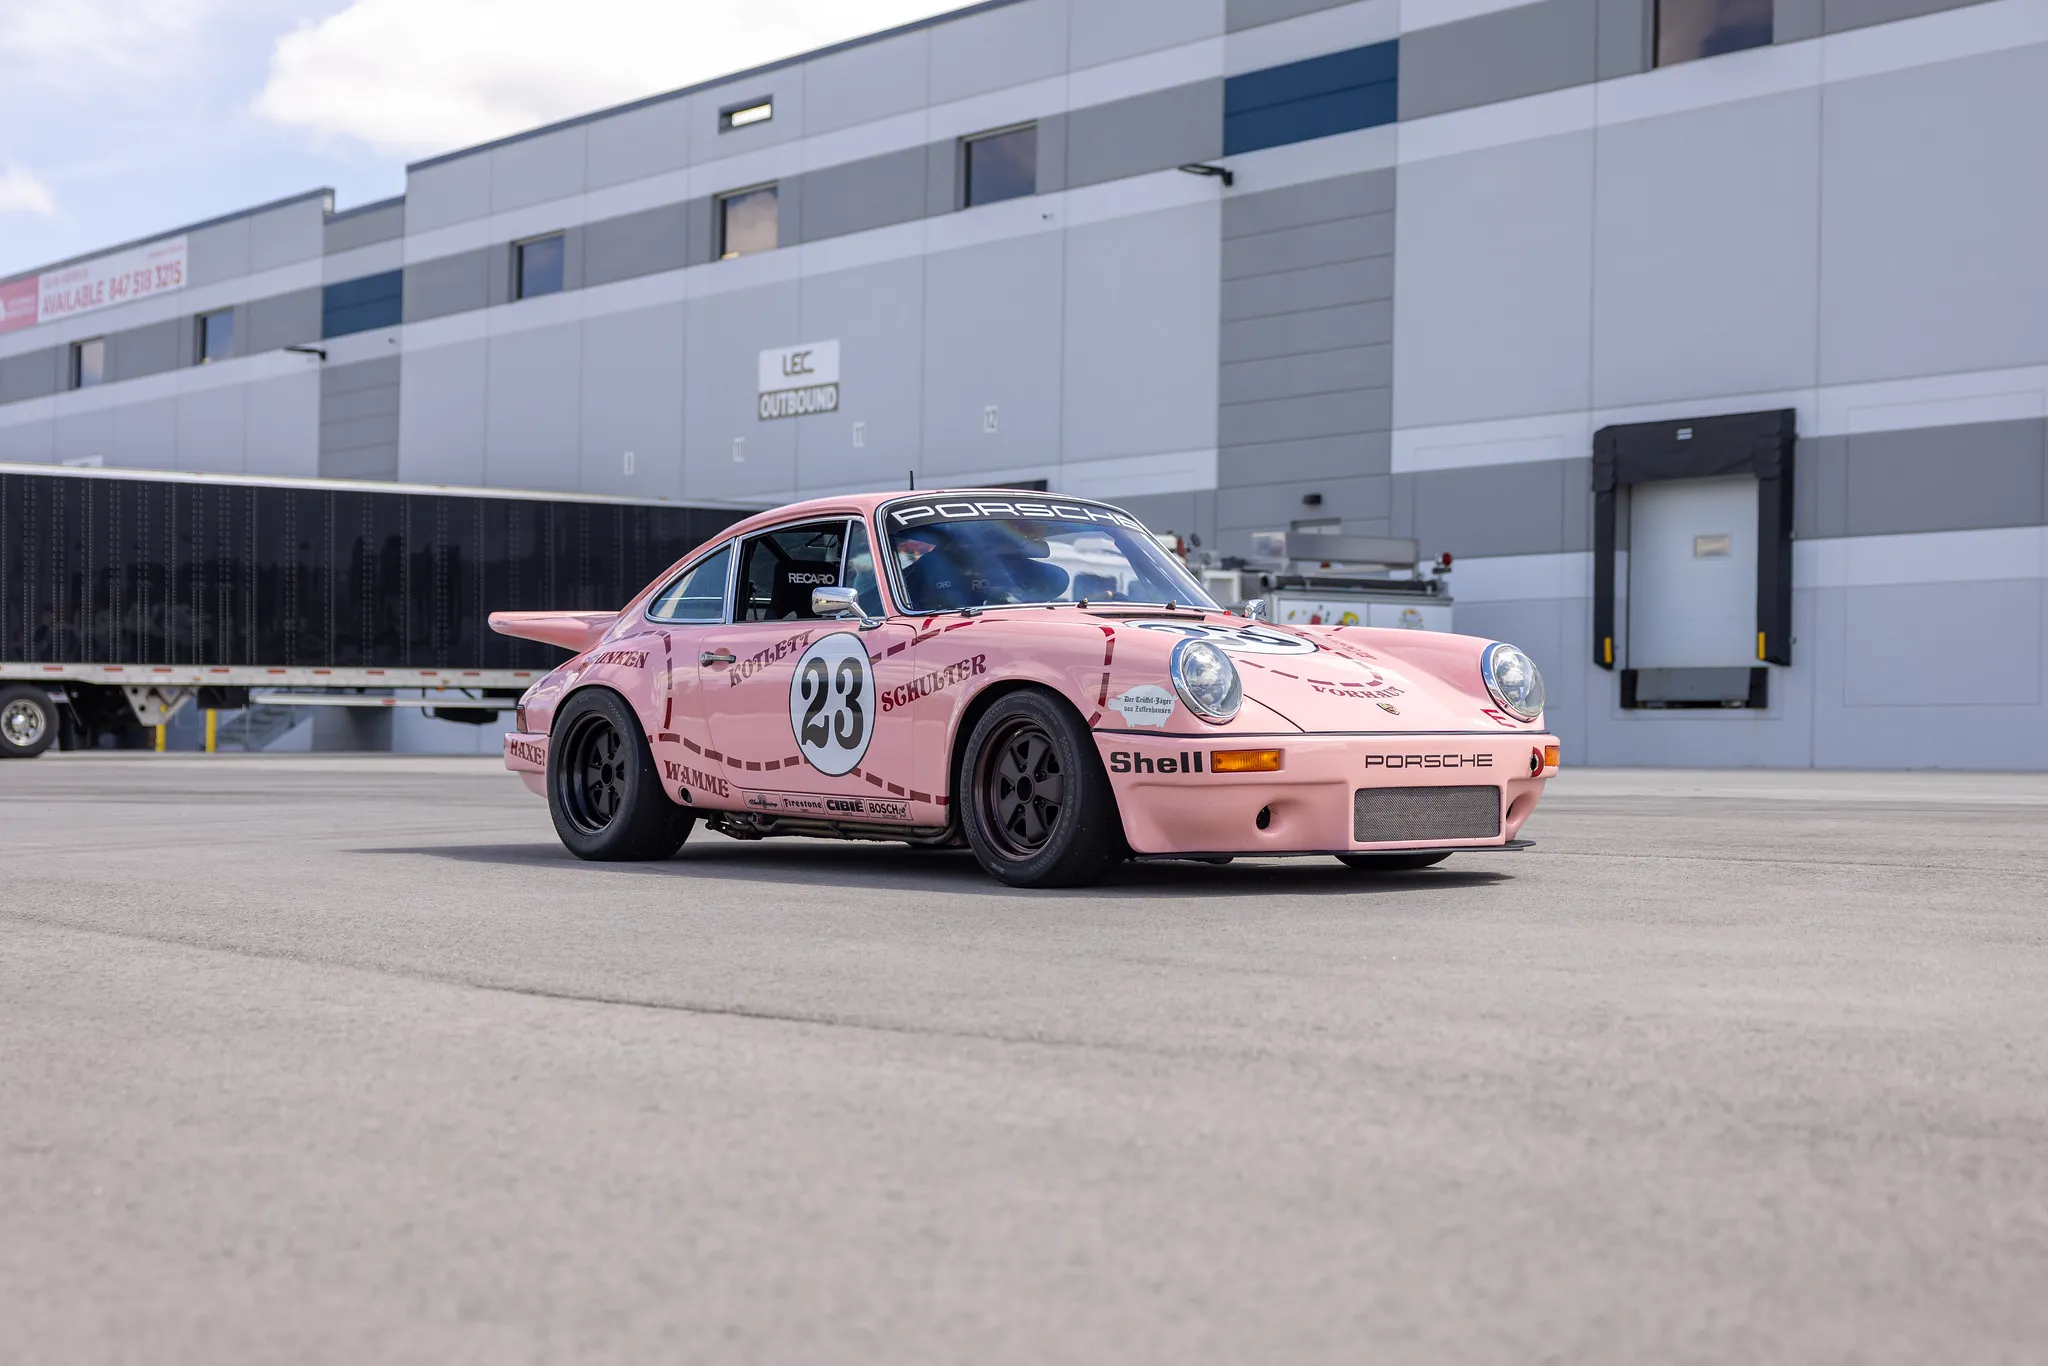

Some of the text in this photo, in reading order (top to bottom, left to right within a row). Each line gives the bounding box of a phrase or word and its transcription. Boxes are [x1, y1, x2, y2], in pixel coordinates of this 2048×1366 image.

[42, 280, 105, 314] AVAILABLE
[109, 273, 131, 301] 847
[133, 269, 152, 295] 518
[154, 261, 182, 288] 3215
[782, 349, 815, 376] LEC
[761, 385, 838, 419] OUTBOUND
[891, 502, 1144, 531] PORSCHE
[788, 572, 835, 585] RECARO
[728, 629, 815, 688] KOTLETT
[881, 653, 987, 713] SCHULTER
[801, 657, 864, 750] 23
[1135, 705, 1172, 714] Zuffenhausen
[1110, 751, 1203, 774] Shell
[1365, 753, 1493, 769] PORSCHE
[664, 760, 730, 798] WAMME
[783, 798, 822, 809] Firestone
[868, 802, 899, 815] BOSCH
